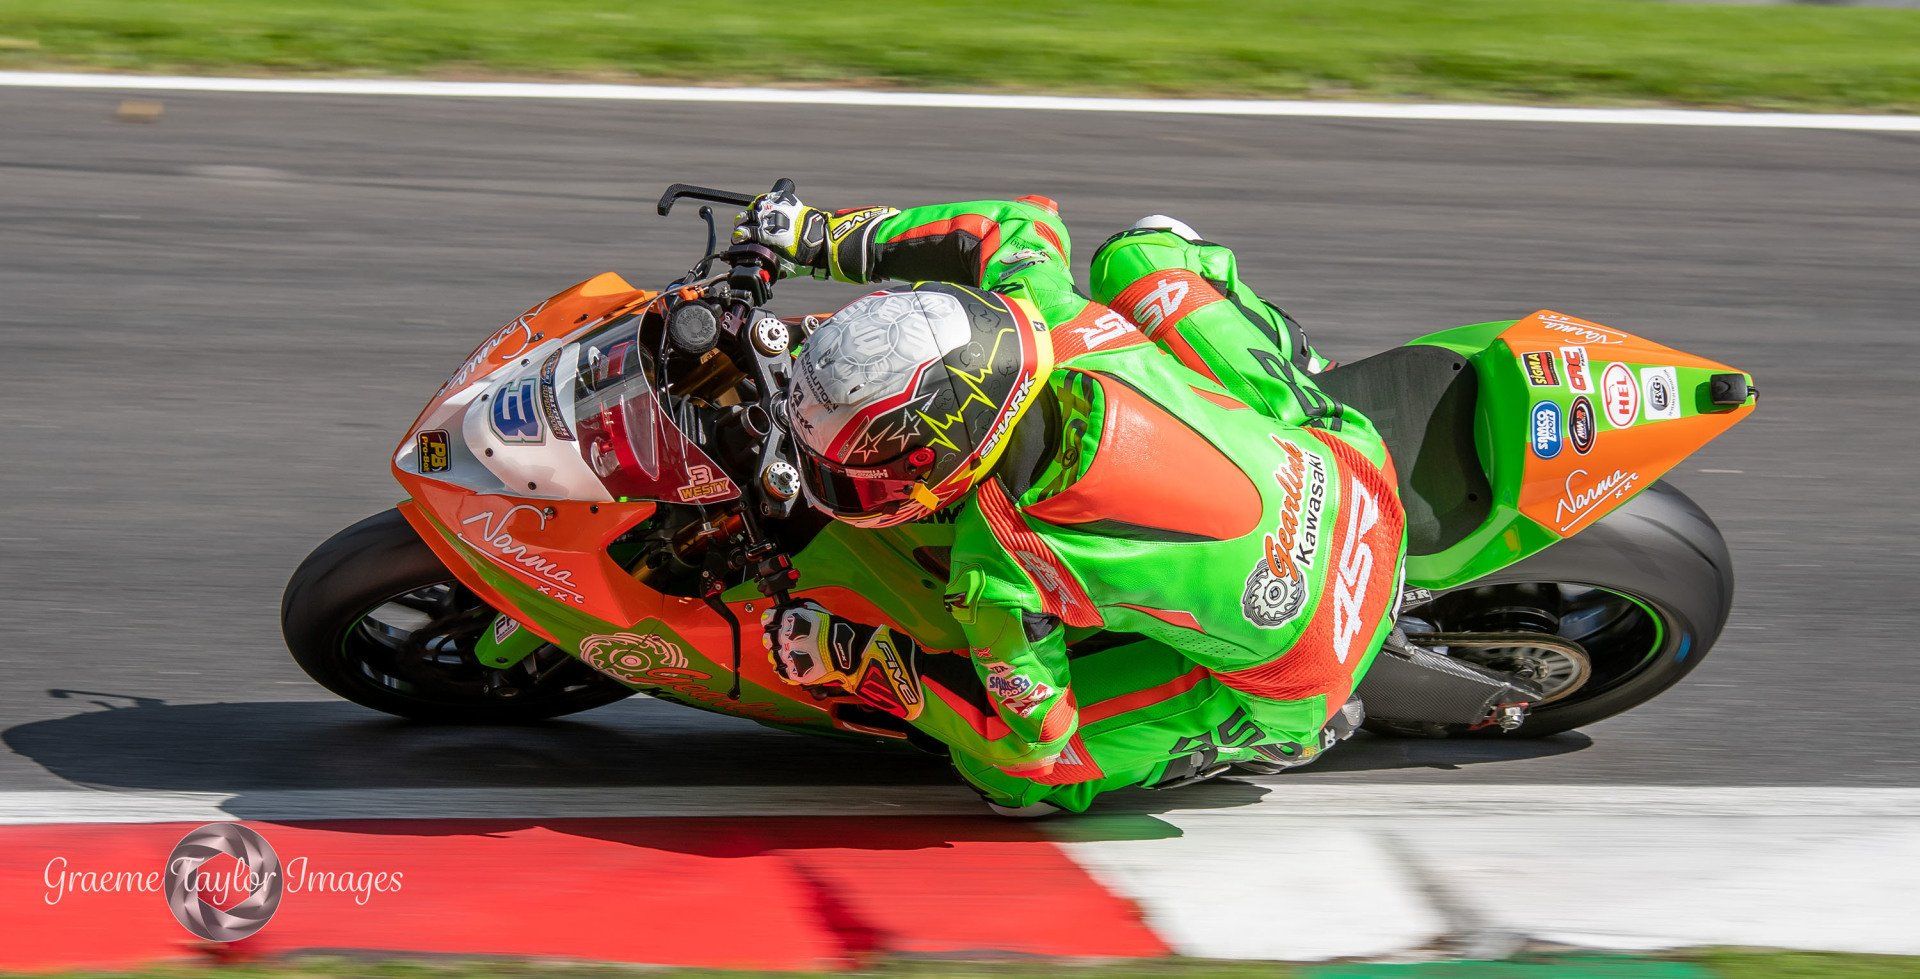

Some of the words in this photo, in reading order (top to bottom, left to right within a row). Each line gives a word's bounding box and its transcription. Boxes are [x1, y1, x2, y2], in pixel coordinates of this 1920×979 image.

[1134, 279, 1189, 336] 4S
[490, 379, 544, 443] 3
[980, 371, 1036, 459] SHARK
[1618, 376, 1630, 415] HEL
[1537, 412, 1549, 450] SAMCO
[1546, 412, 1556, 439] sport
[429, 442, 443, 468] PB
[690, 466, 710, 486] 3
[680, 480, 729, 500] WESTY
[1265, 434, 1303, 582] Gearlink
[1296, 452, 1325, 566] Kawasaki
[1555, 470, 1627, 523] Norma
[461, 504, 577, 588] Norma
[875, 640, 919, 706] FIVE
